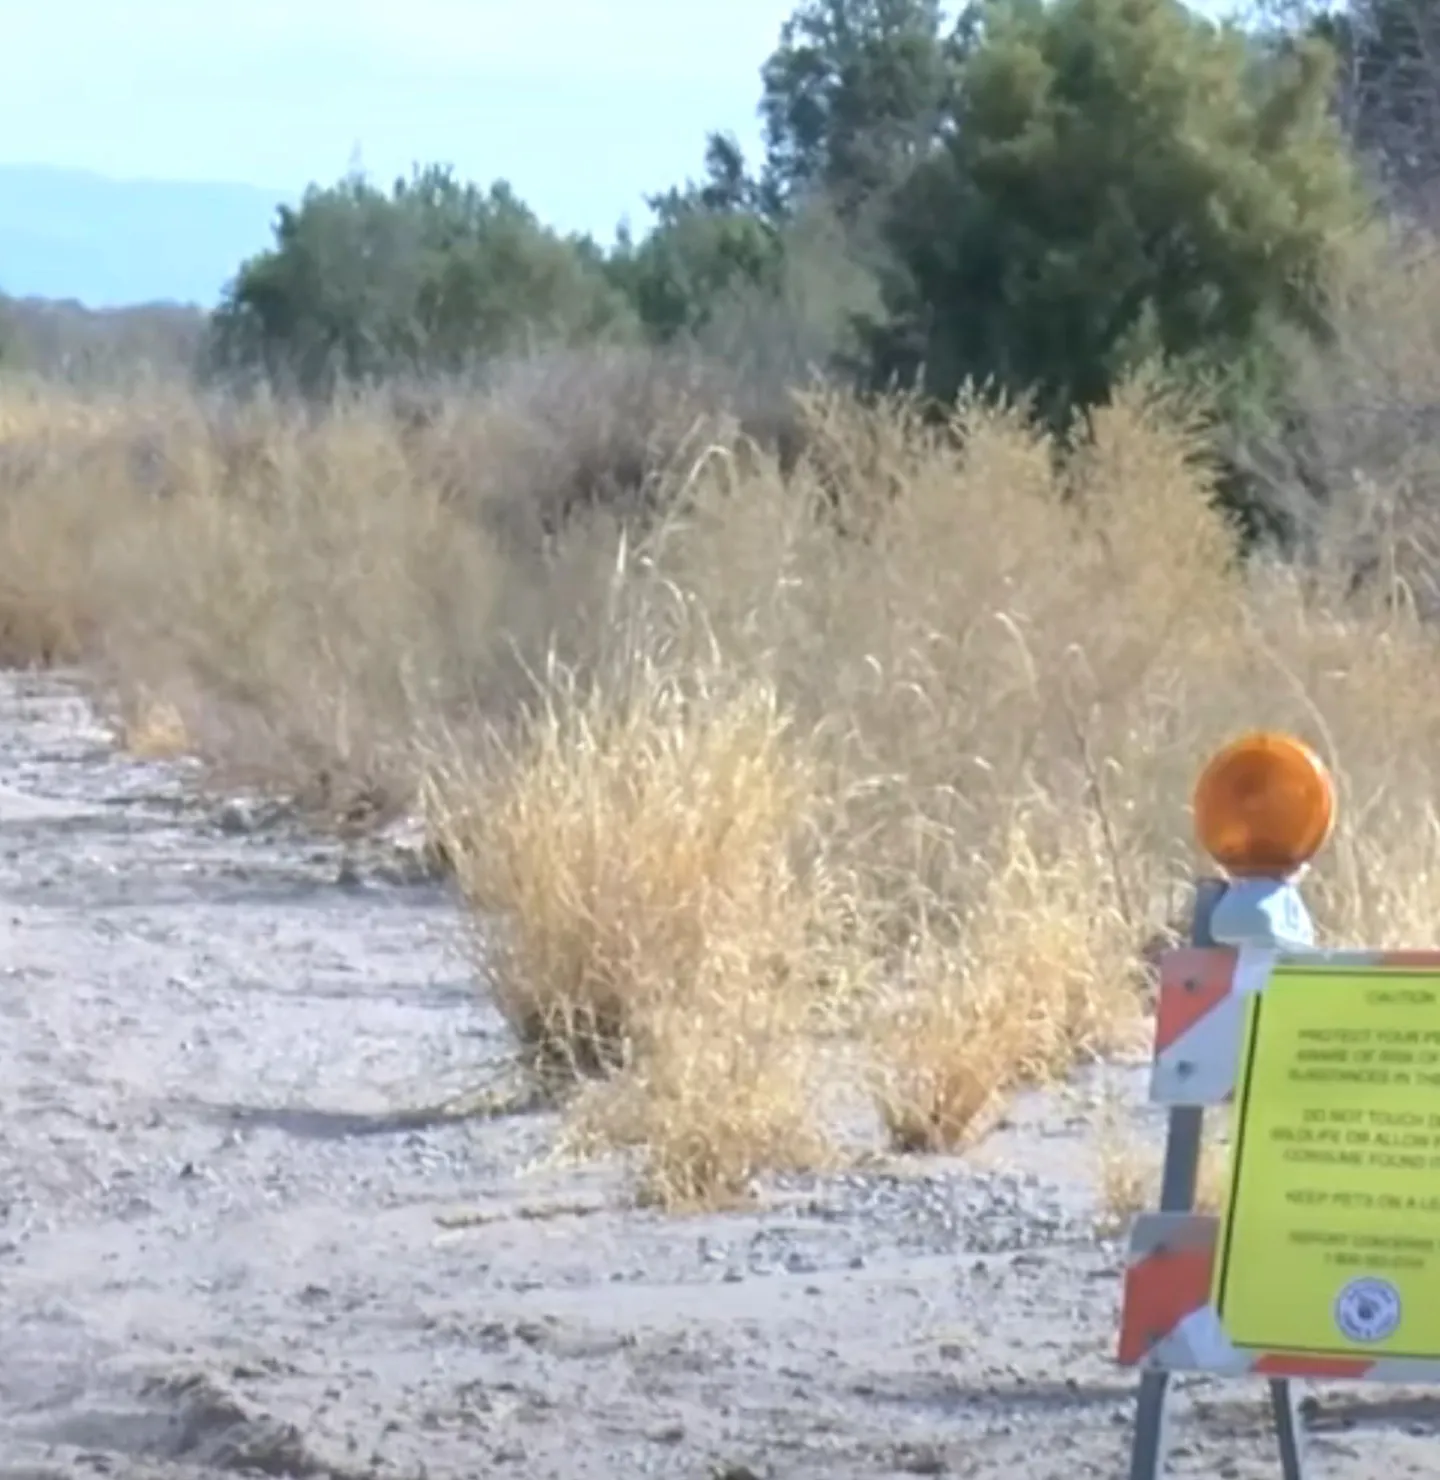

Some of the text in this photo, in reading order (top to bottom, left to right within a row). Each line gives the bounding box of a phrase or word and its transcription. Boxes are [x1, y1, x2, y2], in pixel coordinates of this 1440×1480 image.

[1303, 1108, 1326, 1122] DO
[1329, 1109, 1363, 1123] NOT
[1369, 1109, 1424, 1126] TOUCH
